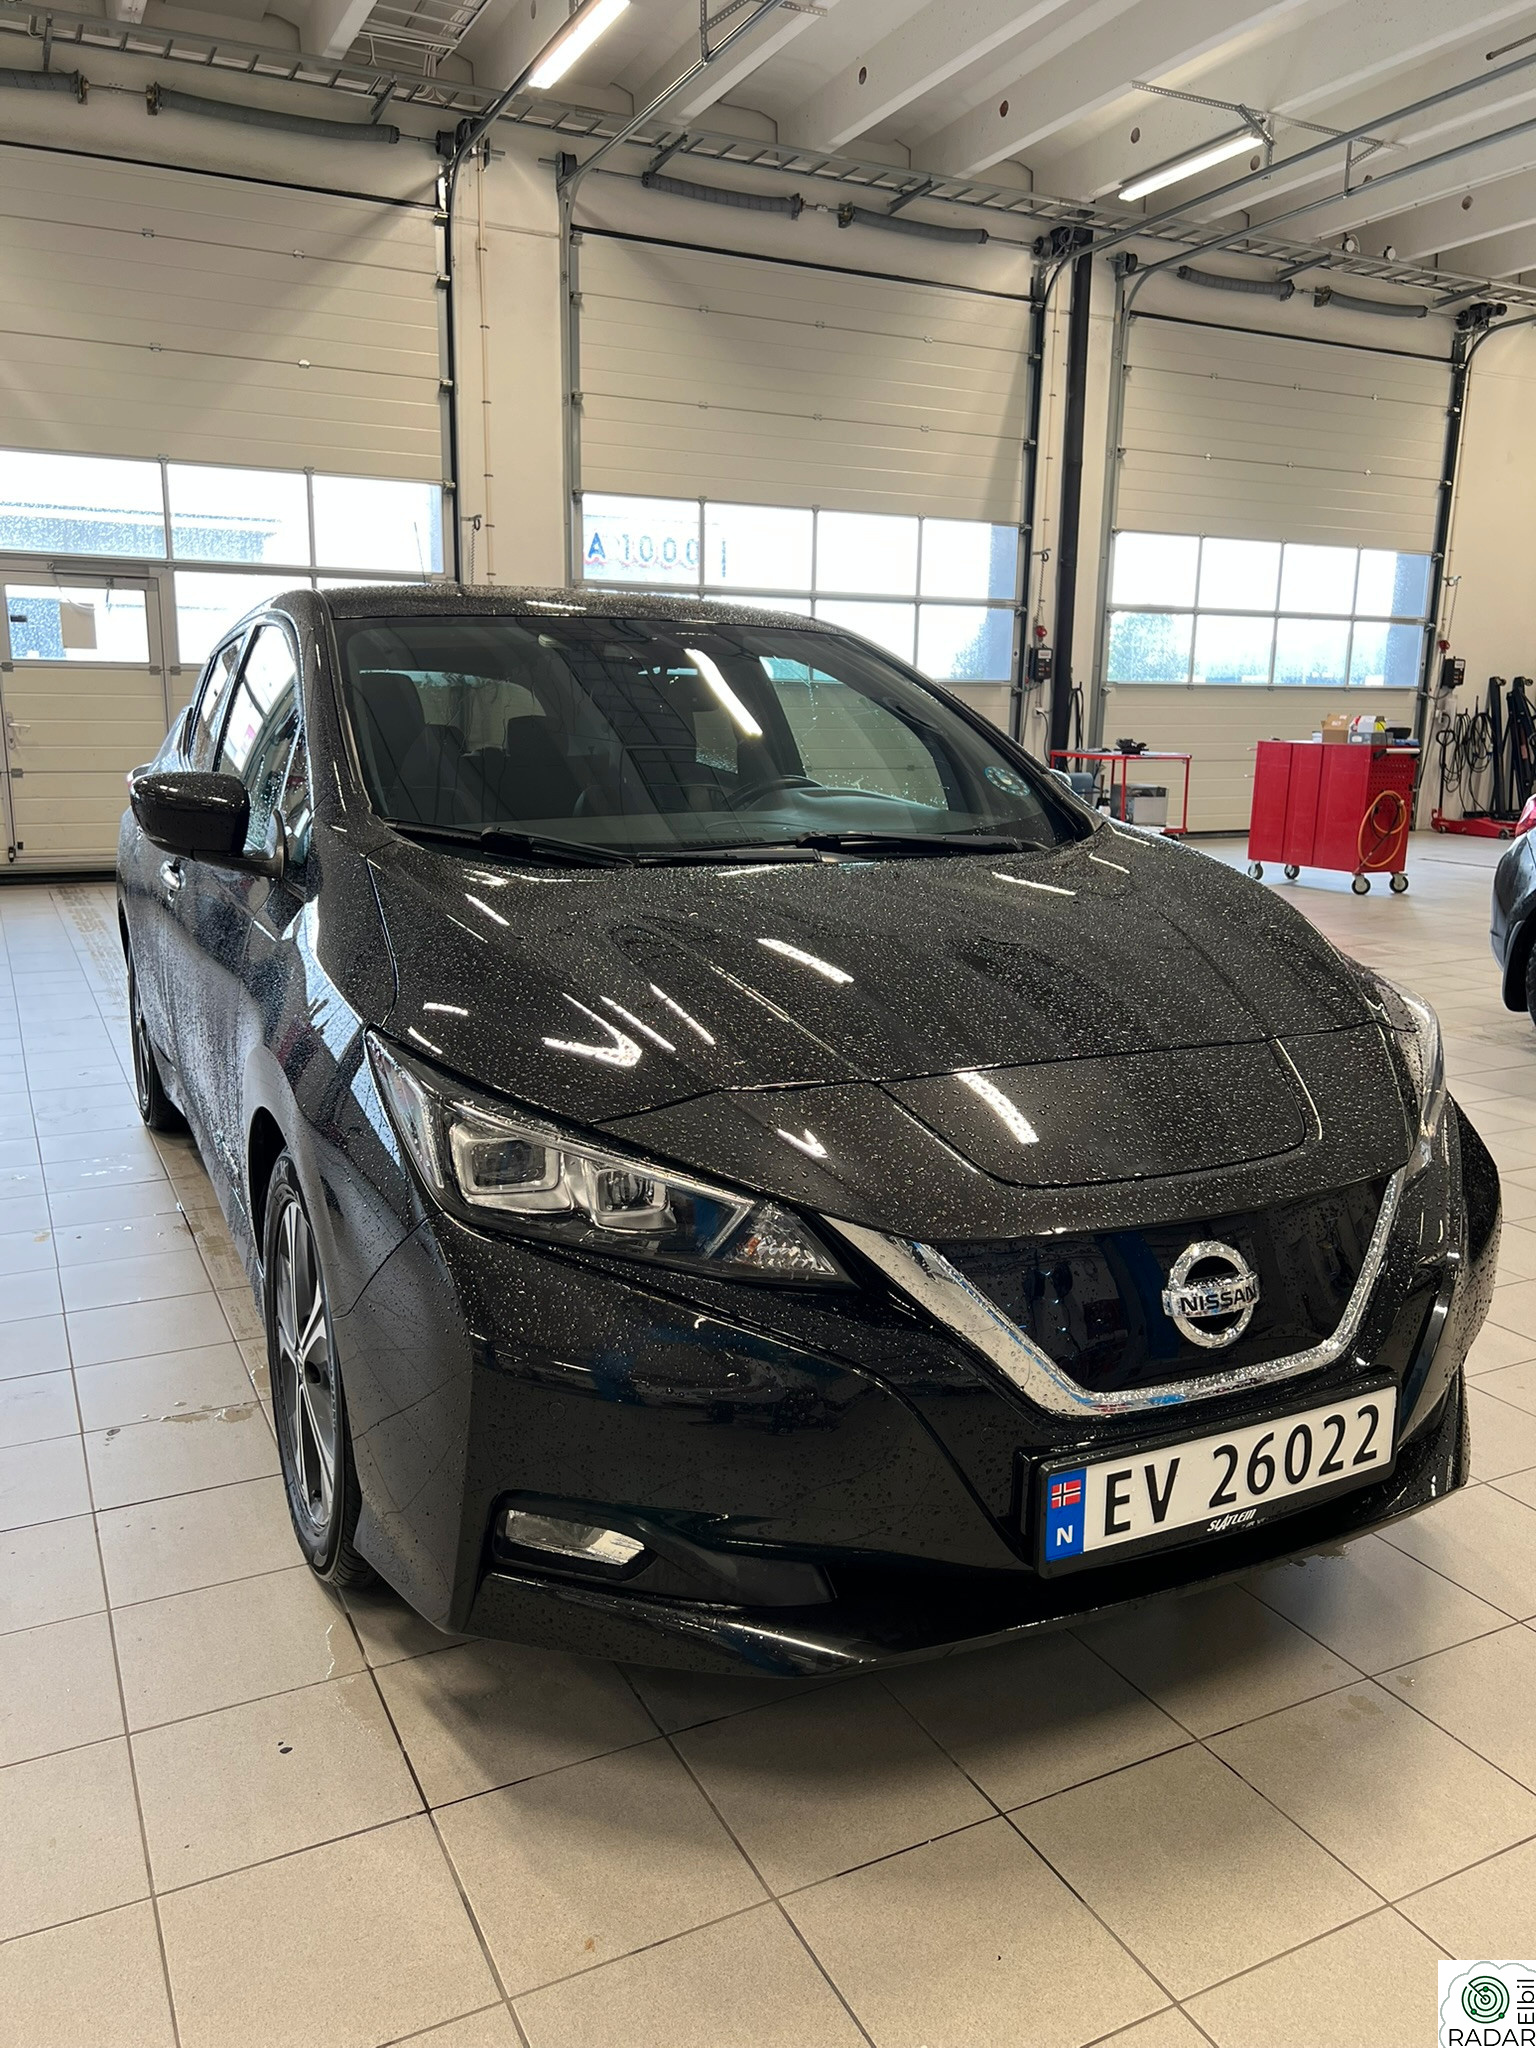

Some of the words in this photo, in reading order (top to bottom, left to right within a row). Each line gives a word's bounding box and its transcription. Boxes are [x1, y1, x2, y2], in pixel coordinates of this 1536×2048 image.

[1180, 1285, 1257, 1312] NISSAN
[1103, 1457, 1181, 1537] EV
[1208, 1404, 1380, 1510] 26022
[1056, 1524, 1074, 1546] N
